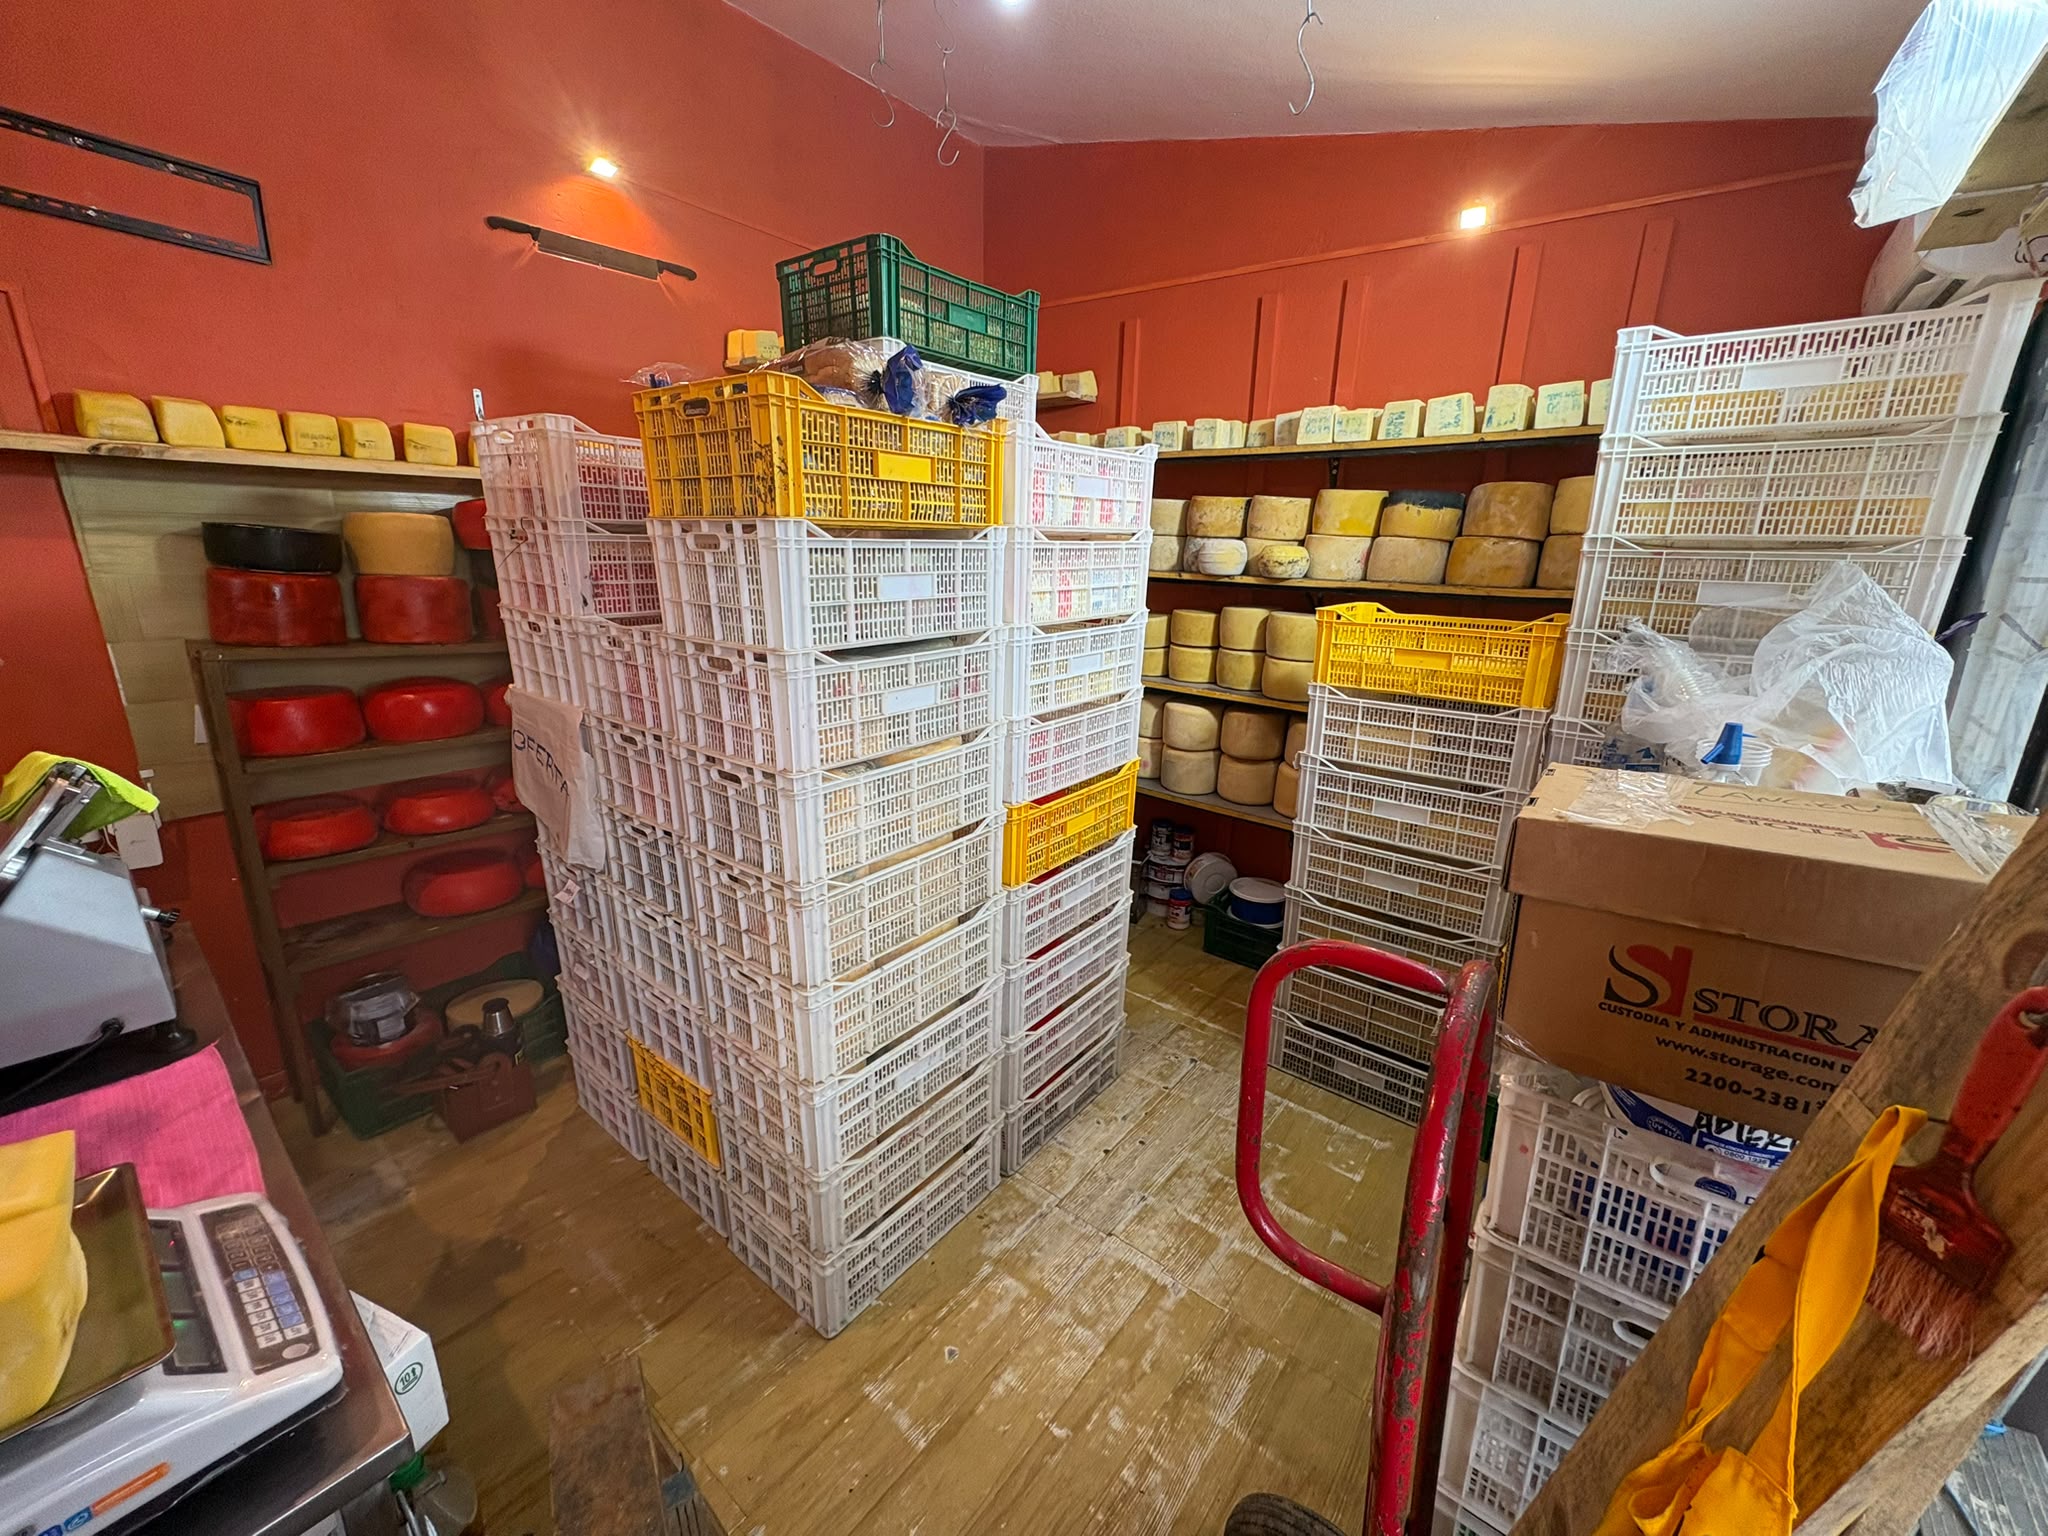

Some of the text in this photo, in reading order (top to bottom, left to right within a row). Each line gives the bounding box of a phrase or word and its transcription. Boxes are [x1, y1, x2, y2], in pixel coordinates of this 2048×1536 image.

[513, 729, 570, 801] OFERTA
[1599, 1001, 1852, 1074] CUSTODIA Y ADMINISTRACION D
[1693, 988, 1878, 1050] STORA
